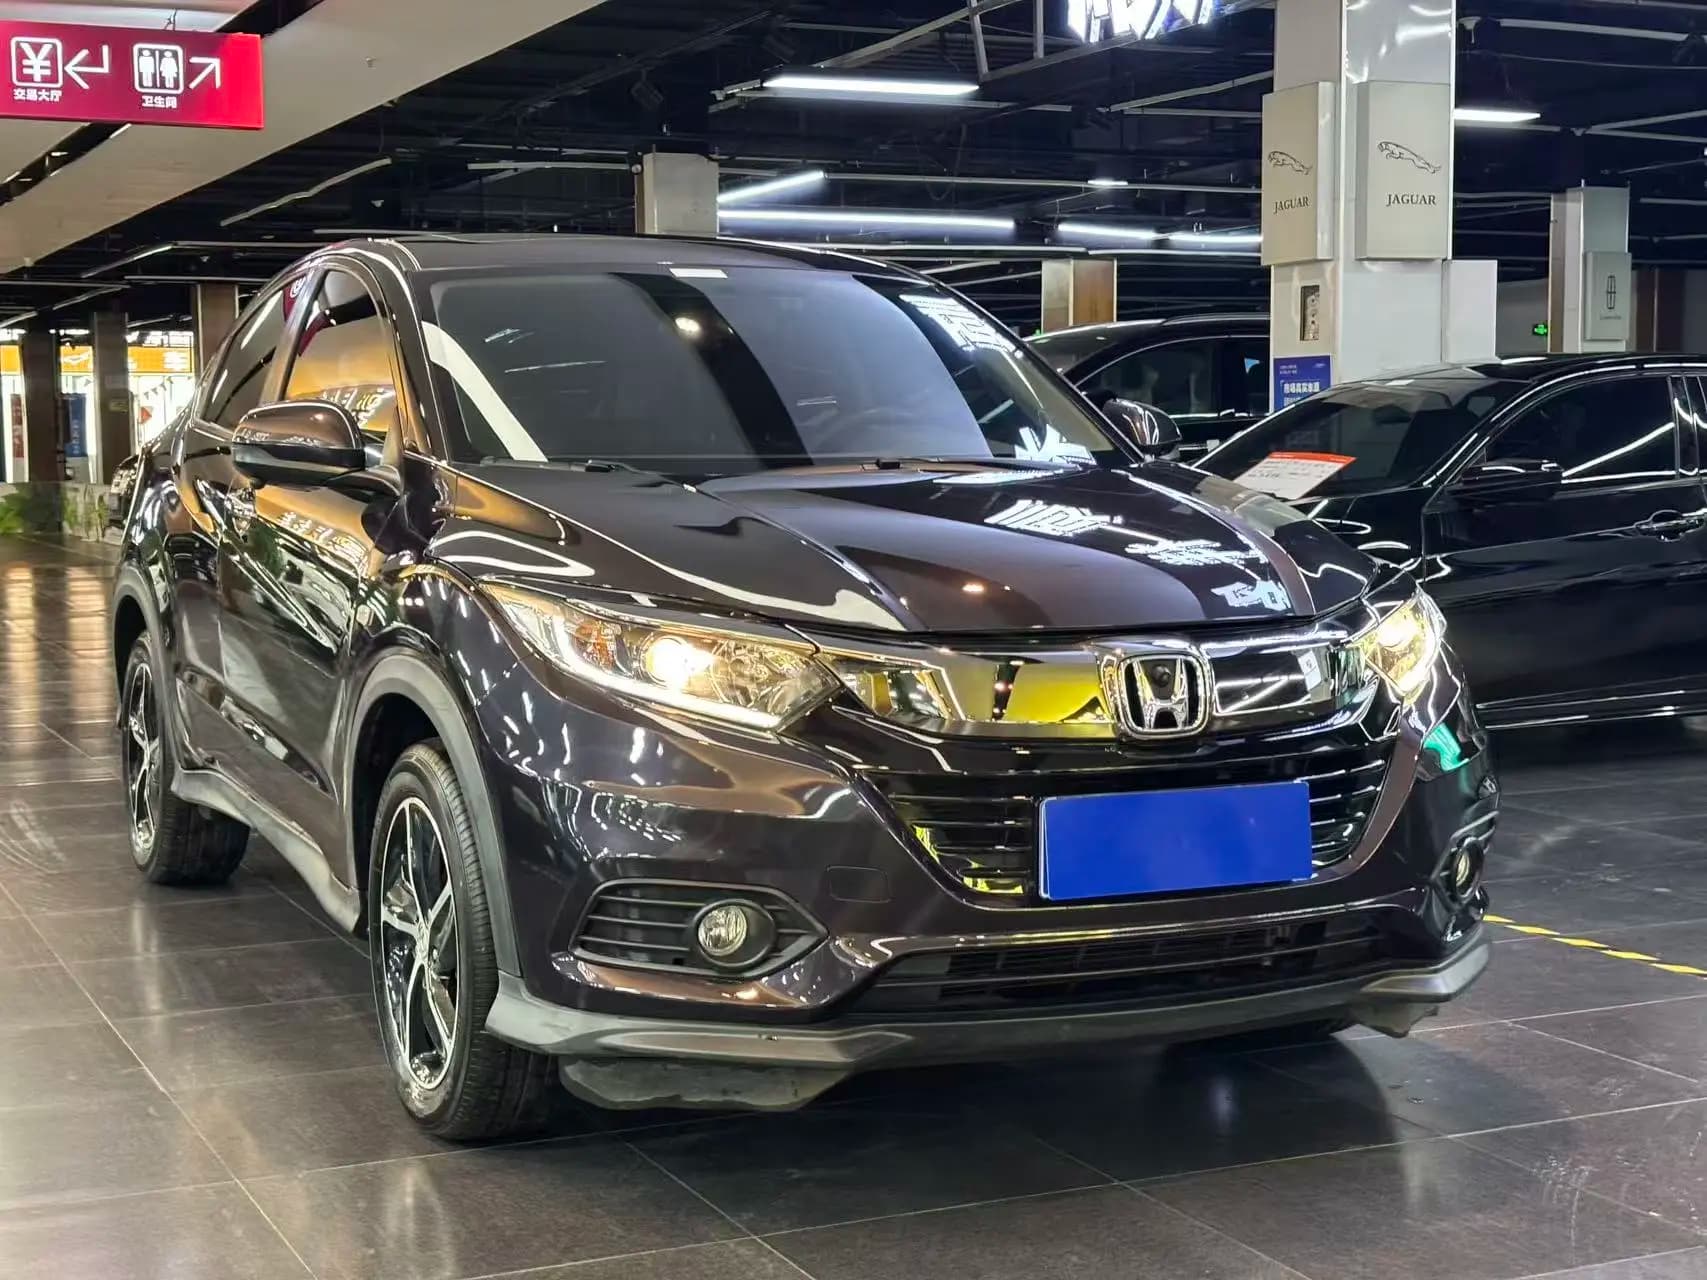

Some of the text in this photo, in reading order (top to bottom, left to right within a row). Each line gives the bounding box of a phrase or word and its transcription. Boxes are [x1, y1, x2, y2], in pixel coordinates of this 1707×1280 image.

[141, 95, 177, 108] 卫生间
[1273, 195, 1310, 214] JAGUAR
[1386, 193, 1437, 207] JAGUAR
